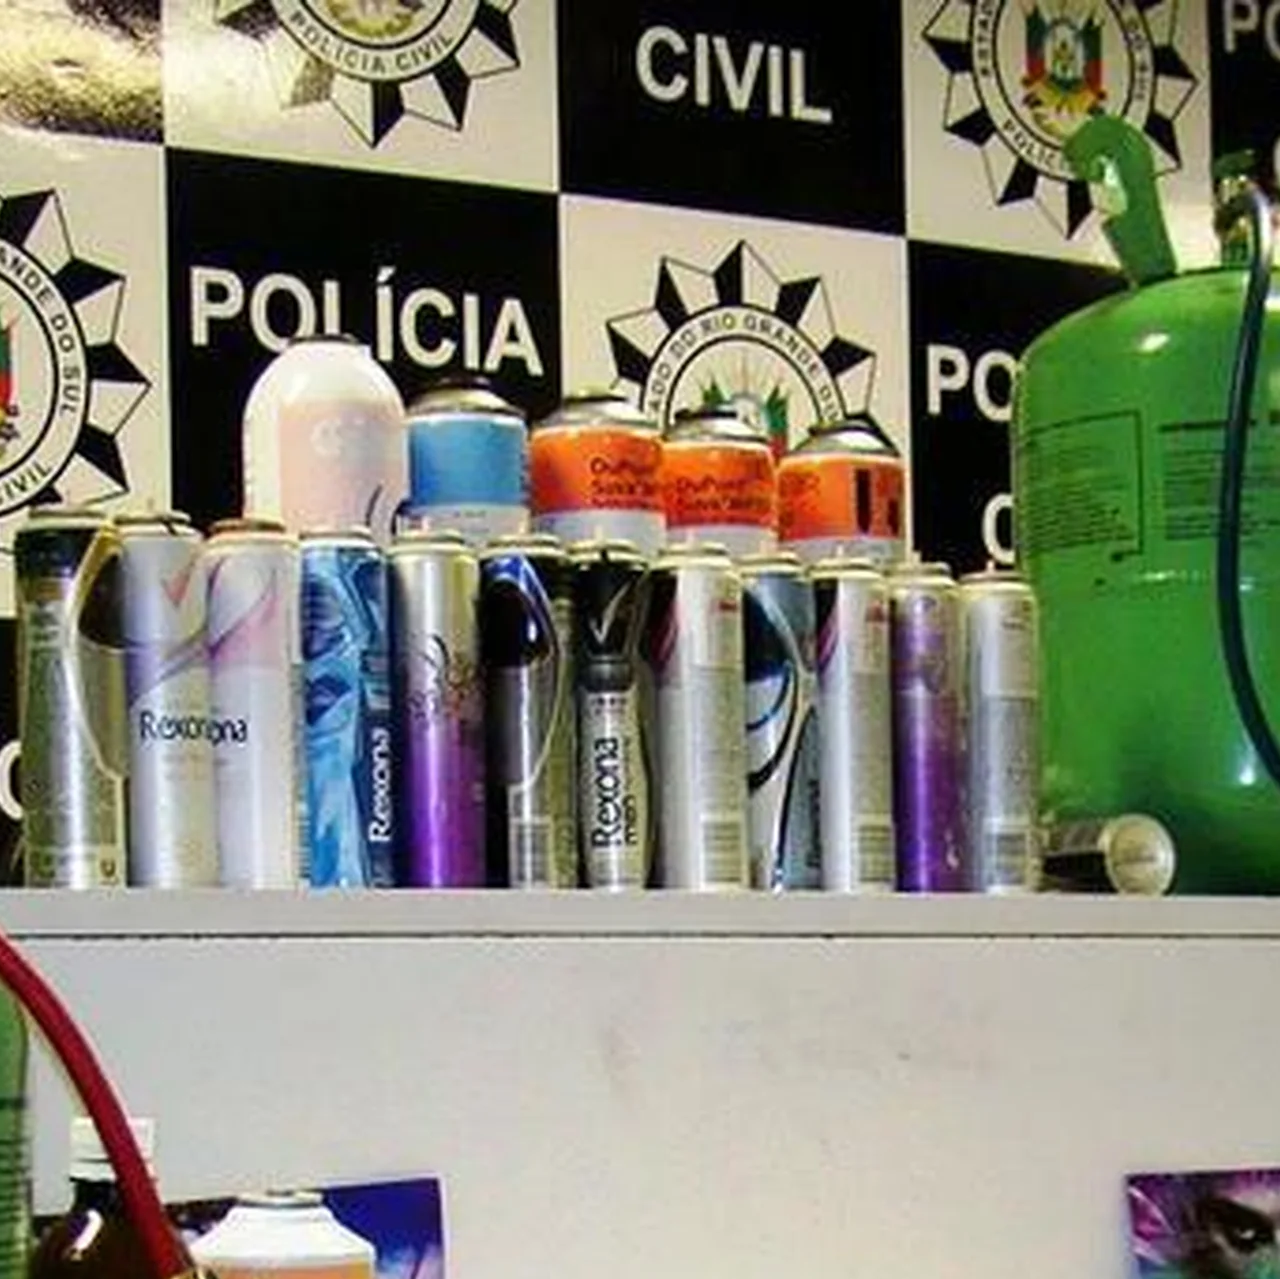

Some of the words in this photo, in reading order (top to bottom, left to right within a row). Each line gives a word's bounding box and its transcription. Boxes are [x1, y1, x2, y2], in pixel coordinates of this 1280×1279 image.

[288, 11, 388, 74] POLÍCIA
[393, 31, 454, 72] CIVIL
[635, 24, 833, 124] CIVIL
[49, 313, 76, 354] DO
[189, 264, 545, 378] POLÍCIA
[702, 312, 736, 333] RIO
[742, 313, 821, 377] GRANDE
[60, 364, 82, 417] SUL
[369, 727, 393, 843] Rexona
[591, 736, 620, 849] Rexona
